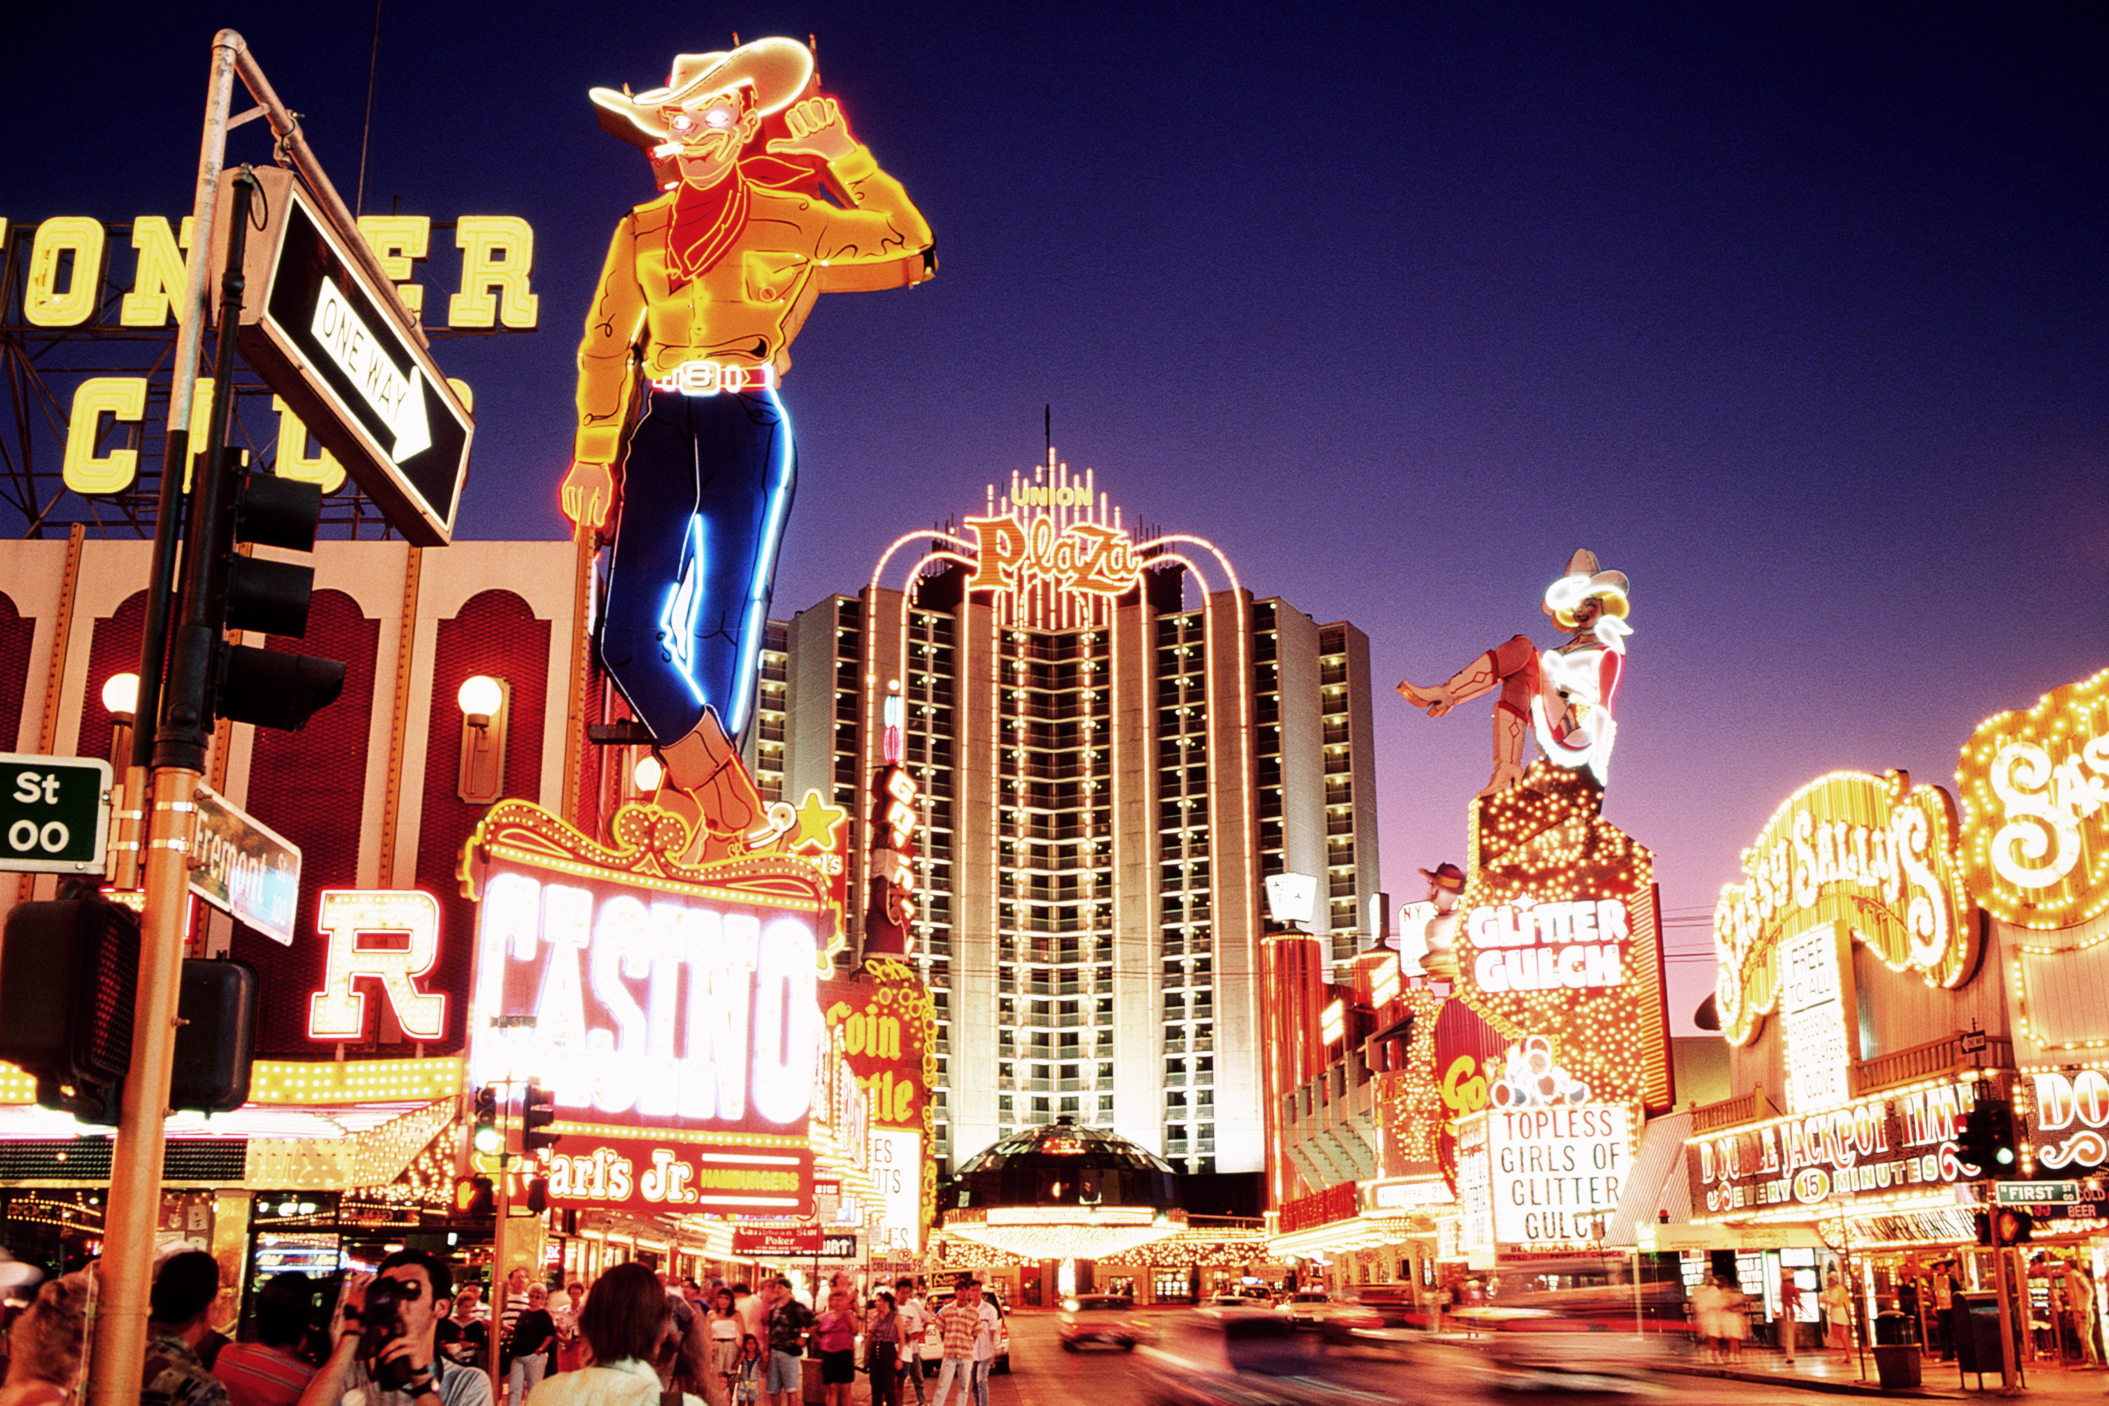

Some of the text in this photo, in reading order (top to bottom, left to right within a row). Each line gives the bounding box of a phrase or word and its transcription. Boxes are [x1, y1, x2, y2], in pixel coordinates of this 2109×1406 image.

[322, 297, 408, 424] ONE WAY
[1011, 487, 1093, 506] UNION
[964, 513, 1143, 596] Plaza
[13, 771, 60, 804] St
[193, 808, 267, 905] Fremont
[1474, 944, 1621, 993] GULCH
[1792, 937, 1824, 977] FREE
[470, 872, 818, 1124] CASINO
[1789, 982, 1804, 1004] TO
[1503, 1110, 1613, 1140] TOPLESS
[1501, 1142, 1620, 1173] GIRLS OF
[1700, 1127, 1779, 1184] DOUBLE
[1780, 1101, 1889, 1178] JACKPOT
[641, 1151, 695, 1200] Jr.
[700, 1168, 799, 1192] HAMBURGERS
[1512, 1176, 1620, 1206] GLITTER
[1733, 1154, 1939, 1208] EVERY 15 MINUTES
[2009, 1186, 2054, 1200] FIRST
[2062, 1185, 2072, 1193] ST
[2067, 1204, 2097, 1218] BEER
[765, 1236, 795, 1245] Poker
